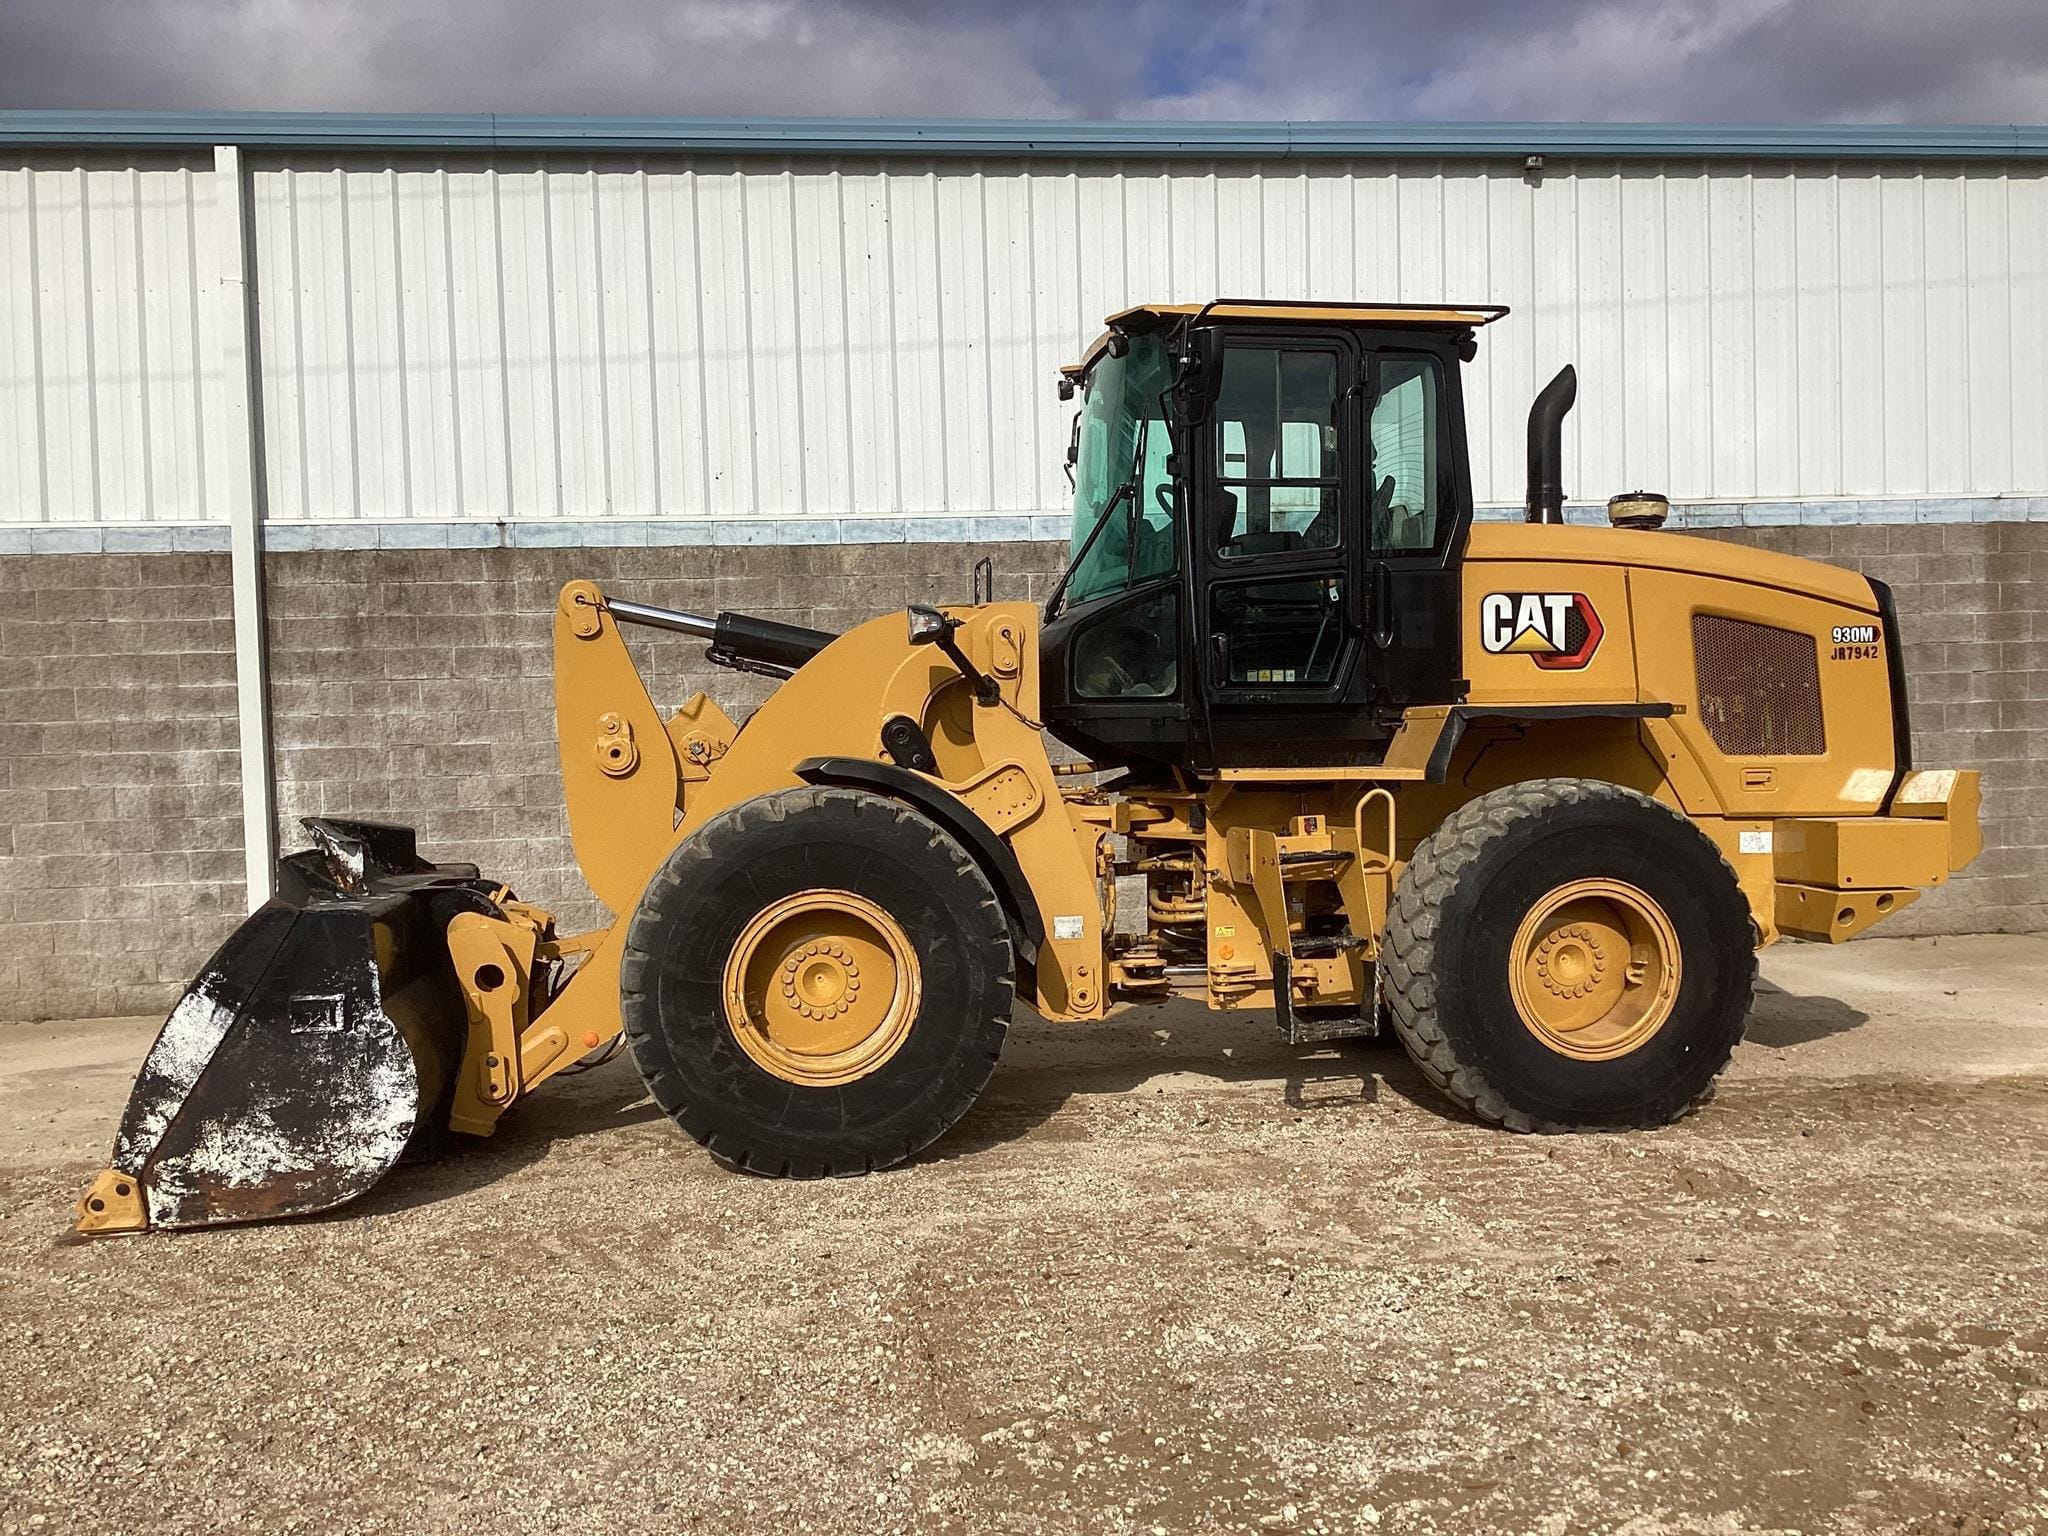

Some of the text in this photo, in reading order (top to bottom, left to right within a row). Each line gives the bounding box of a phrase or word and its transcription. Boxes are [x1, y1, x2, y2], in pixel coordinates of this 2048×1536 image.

[1483, 594, 1573, 652] CAT
[1832, 626, 1873, 643] 930M
[1831, 645, 1878, 660] JR7942
